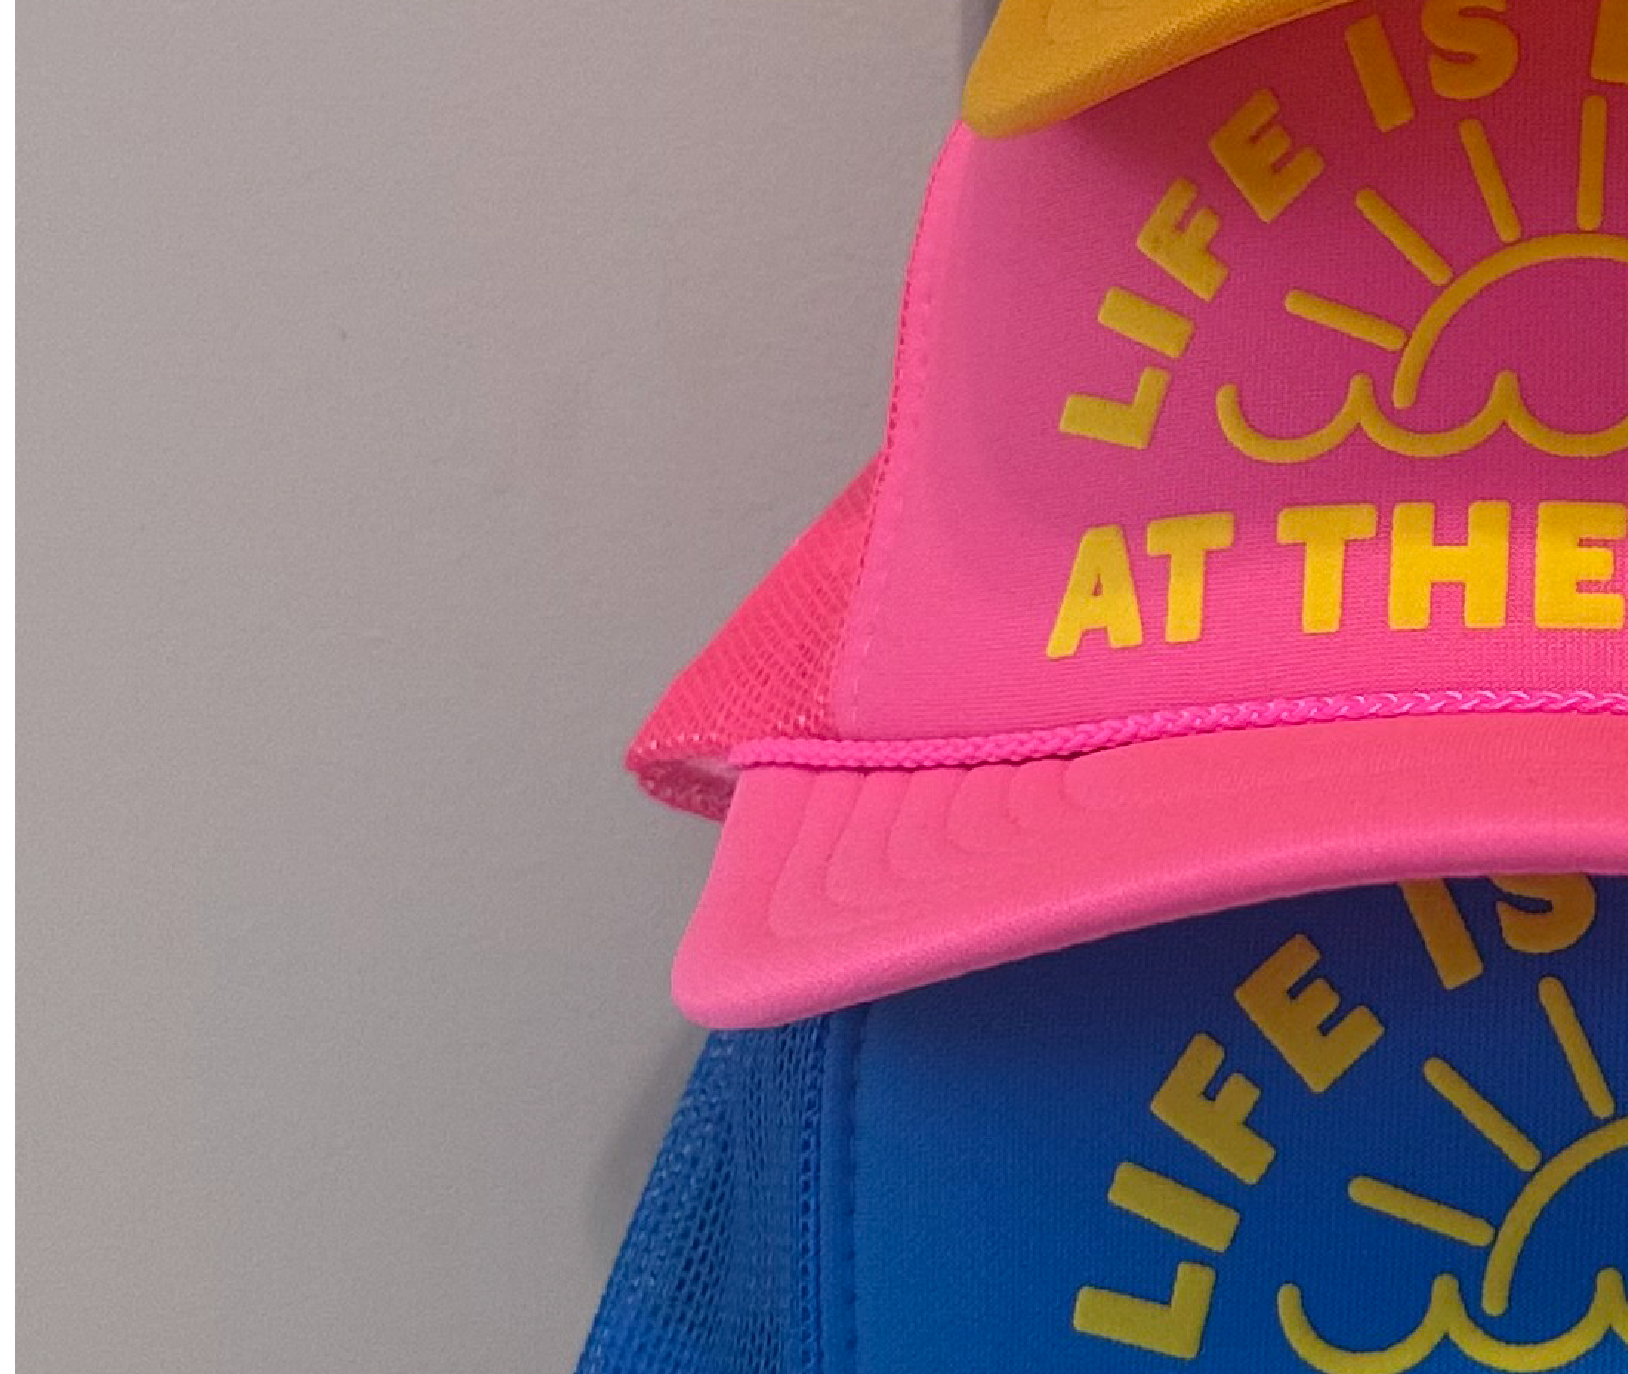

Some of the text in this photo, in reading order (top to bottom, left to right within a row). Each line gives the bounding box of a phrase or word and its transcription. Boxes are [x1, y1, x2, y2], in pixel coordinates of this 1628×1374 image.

[1060, 89, 1323, 448] LIFE
[1047, 514, 1234, 658] AT
[1278, 502, 1626, 633] THE
[1074, 933, 1384, 1358] LIFE
[1399, 873, 1596, 989] IS
